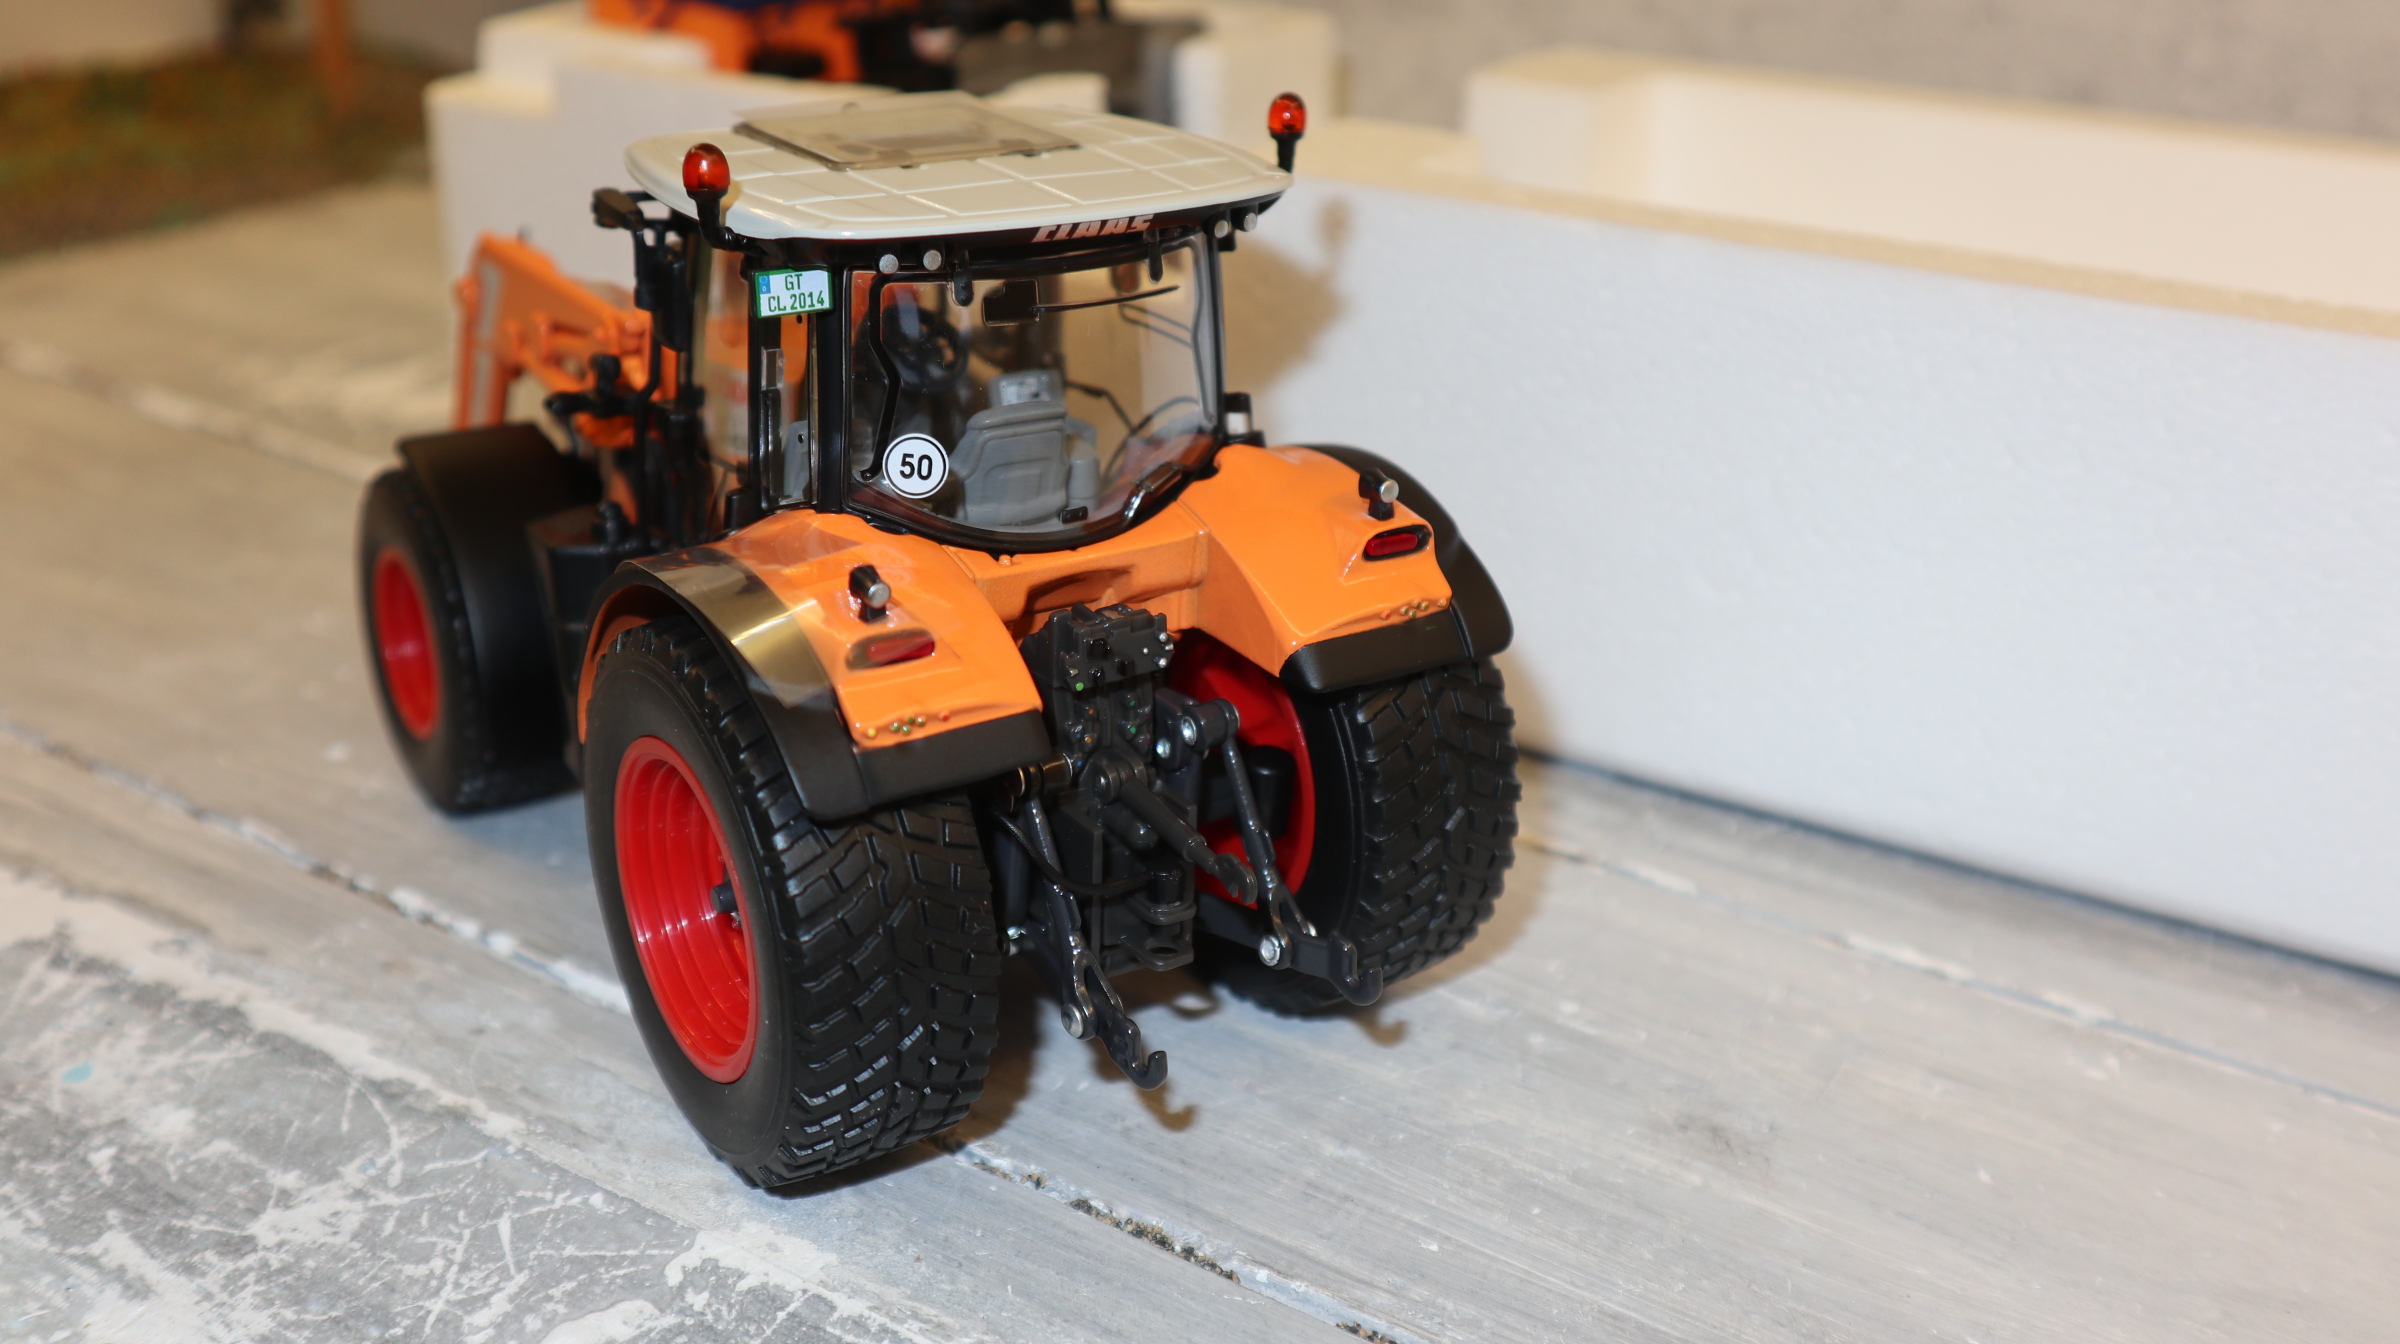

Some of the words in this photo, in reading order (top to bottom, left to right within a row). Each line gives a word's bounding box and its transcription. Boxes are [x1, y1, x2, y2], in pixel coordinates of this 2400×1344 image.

[1031, 213, 1155, 243] CLAAS
[785, 273, 802, 291] GT
[768, 295, 786, 312] CL
[790, 290, 824, 310] 2014
[900, 453, 933, 480] 50
